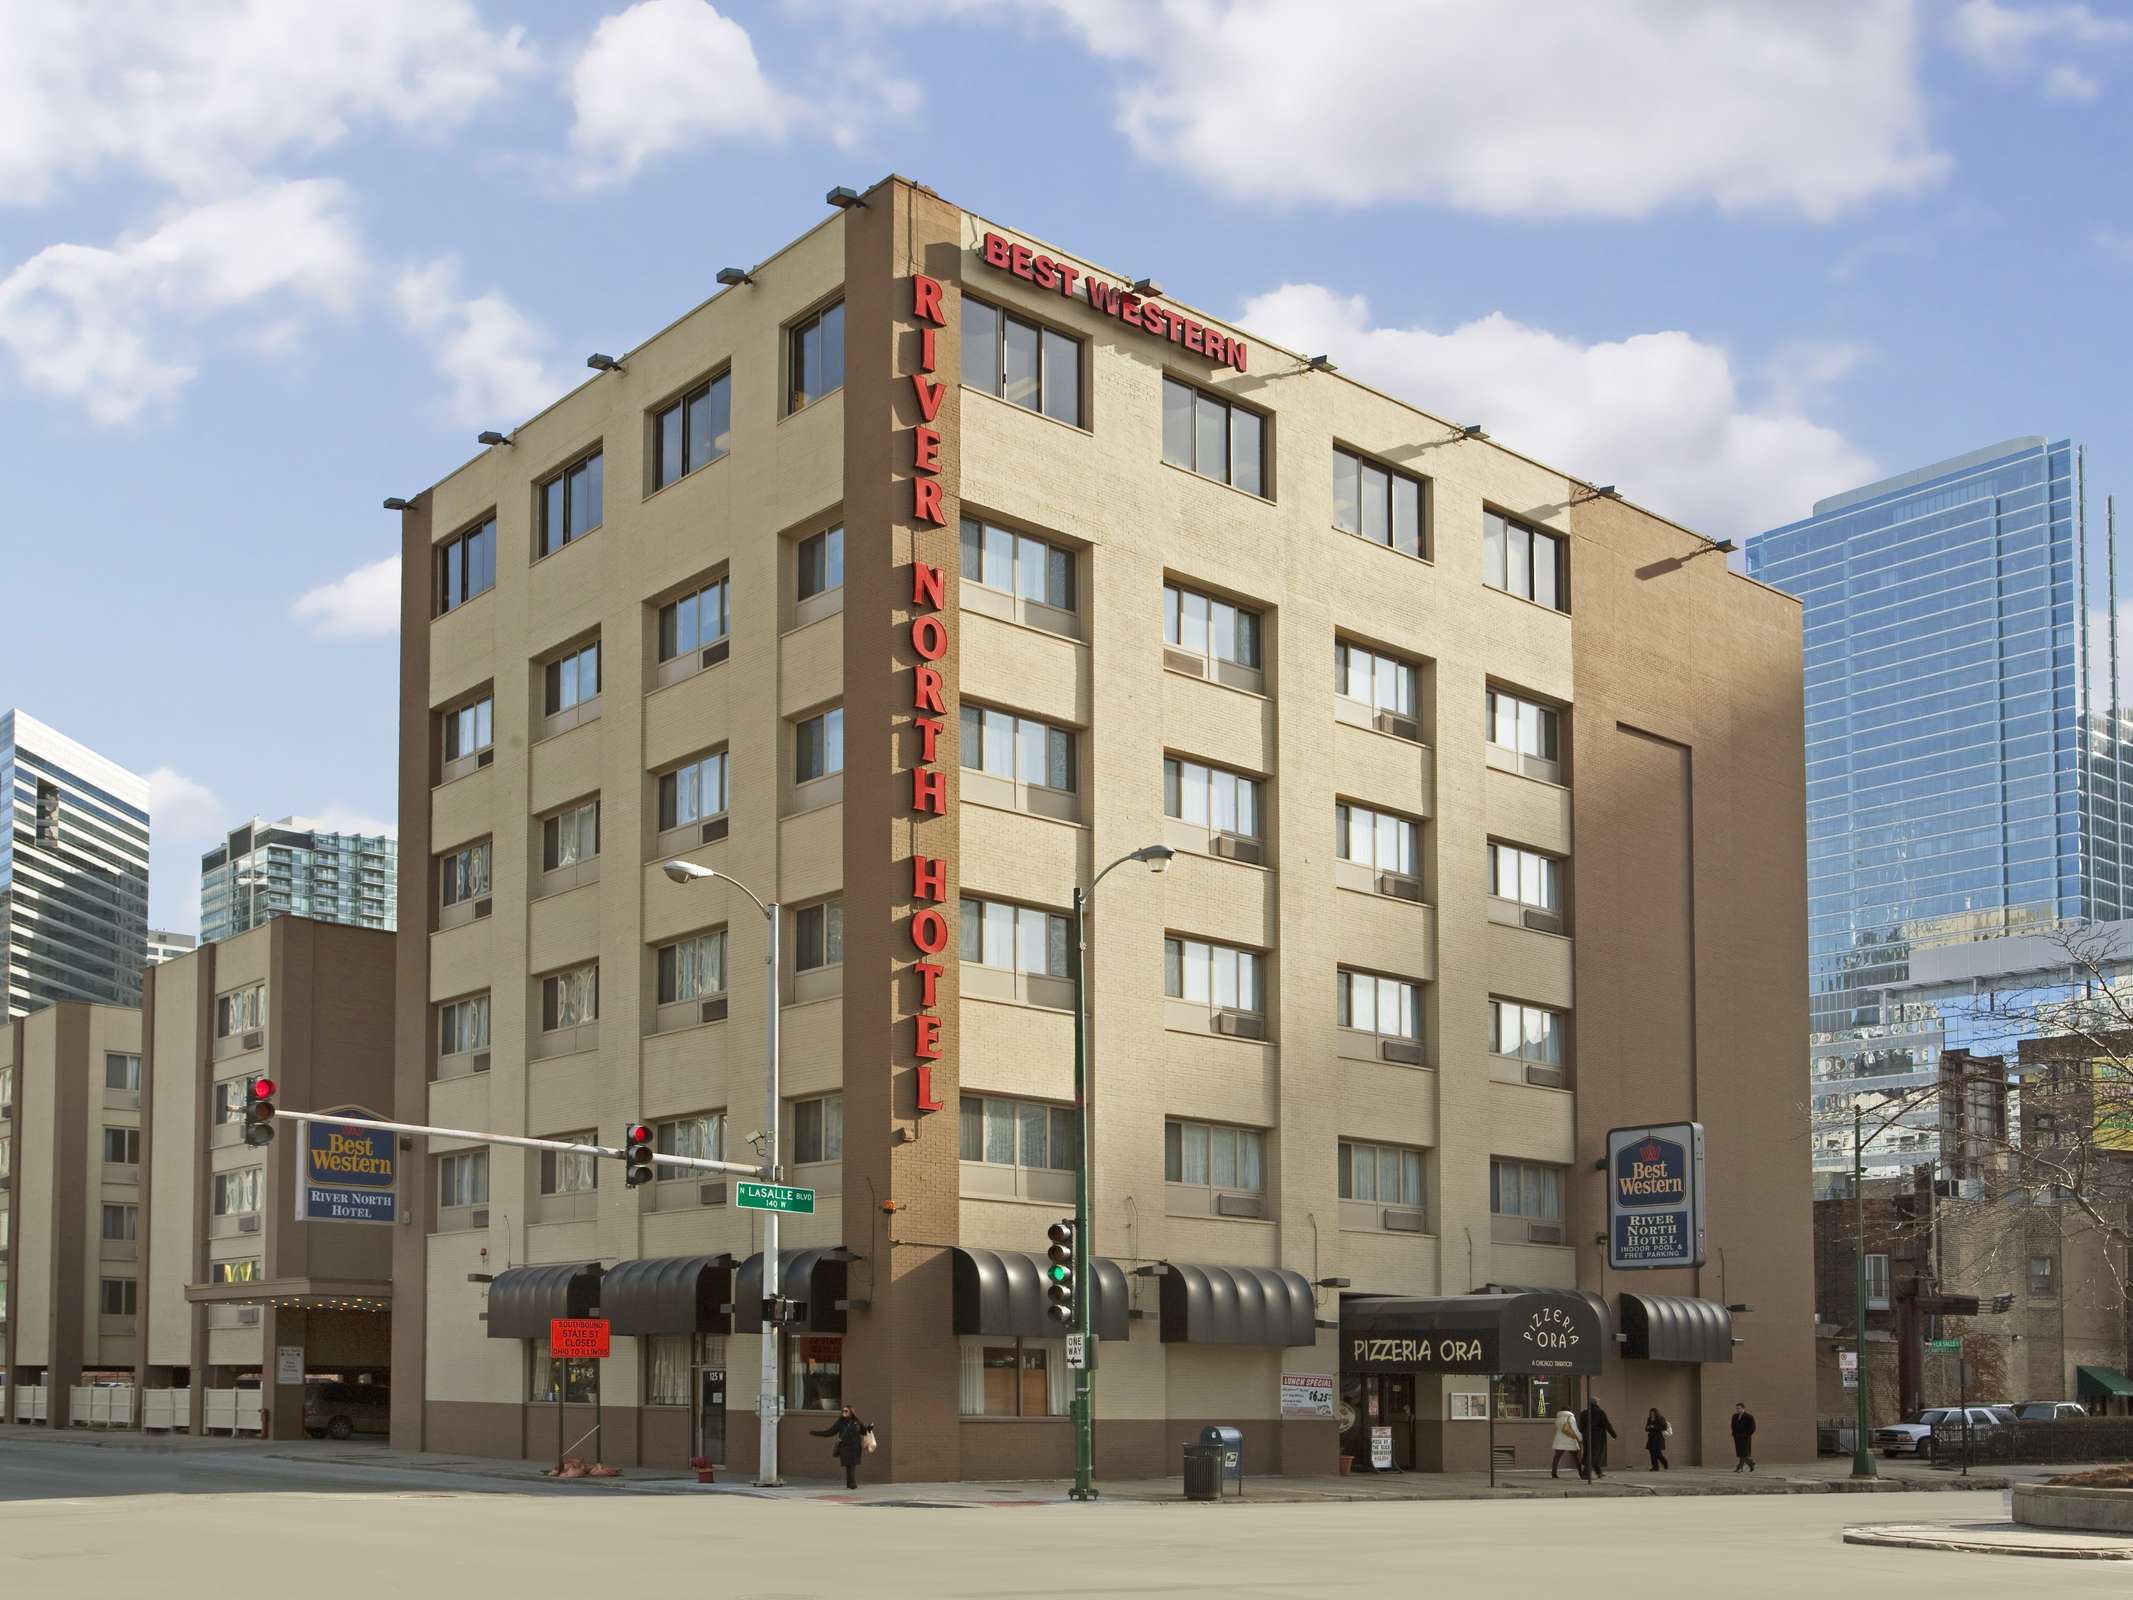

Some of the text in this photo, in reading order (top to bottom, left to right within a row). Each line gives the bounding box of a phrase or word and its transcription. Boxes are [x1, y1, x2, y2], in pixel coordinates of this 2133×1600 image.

[984, 232, 1247, 373] BEST WESTERN
[911, 274, 948, 1111] RIVER NORTH HOTEL
[328, 1133, 374, 1156] Best
[311, 1149, 392, 1175] Western
[1632, 1161, 1667, 1180] Best
[1619, 1177, 1683, 1195] Western
[311, 1190, 392, 1206] RIVER NORTH
[796, 1192, 812, 1201] BLVD
[766, 1200, 777, 1208] 140
[332, 1205, 372, 1218] HOTEL
[1629, 1214, 1674, 1226] RIVER
[1627, 1224, 1677, 1236] NORTH
[1628, 1235, 1677, 1246] HOTEL
[1646, 1250, 1680, 1258] PARKING
[1523, 1308, 1579, 1344] PIZZERIA
[562, 1329, 599, 1338] STATE ST
[565, 1339, 597, 1347] CLOSED
[1068, 1337, 1081, 1346] ONE
[1537, 1332, 1567, 1348] ORA
[1068, 1346, 1081, 1355] WAY
[1354, 1339, 1482, 1361] PIZZERIA ORA
[1284, 1376, 1332, 1388] LUNCH SPECIAL
